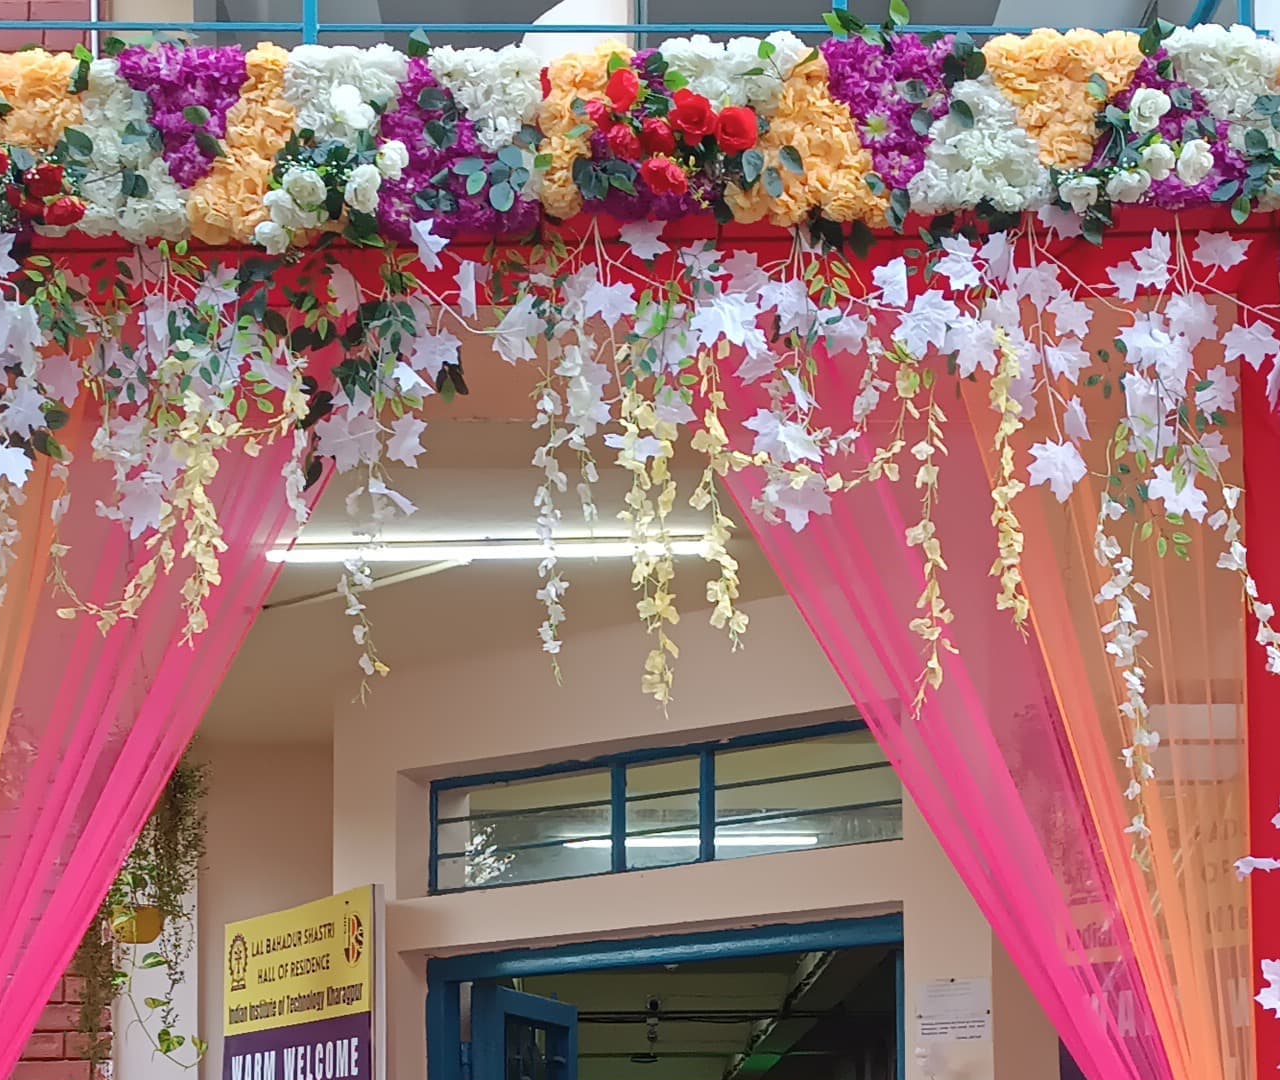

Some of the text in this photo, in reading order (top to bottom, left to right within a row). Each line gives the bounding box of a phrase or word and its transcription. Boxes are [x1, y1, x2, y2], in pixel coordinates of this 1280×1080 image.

[251, 938, 264, 957] LAL
[266, 930, 302, 955] BAHADUR
[304, 921, 335, 945] SHASTRI
[257, 953, 330, 985] HALL OF RESIDENCE
